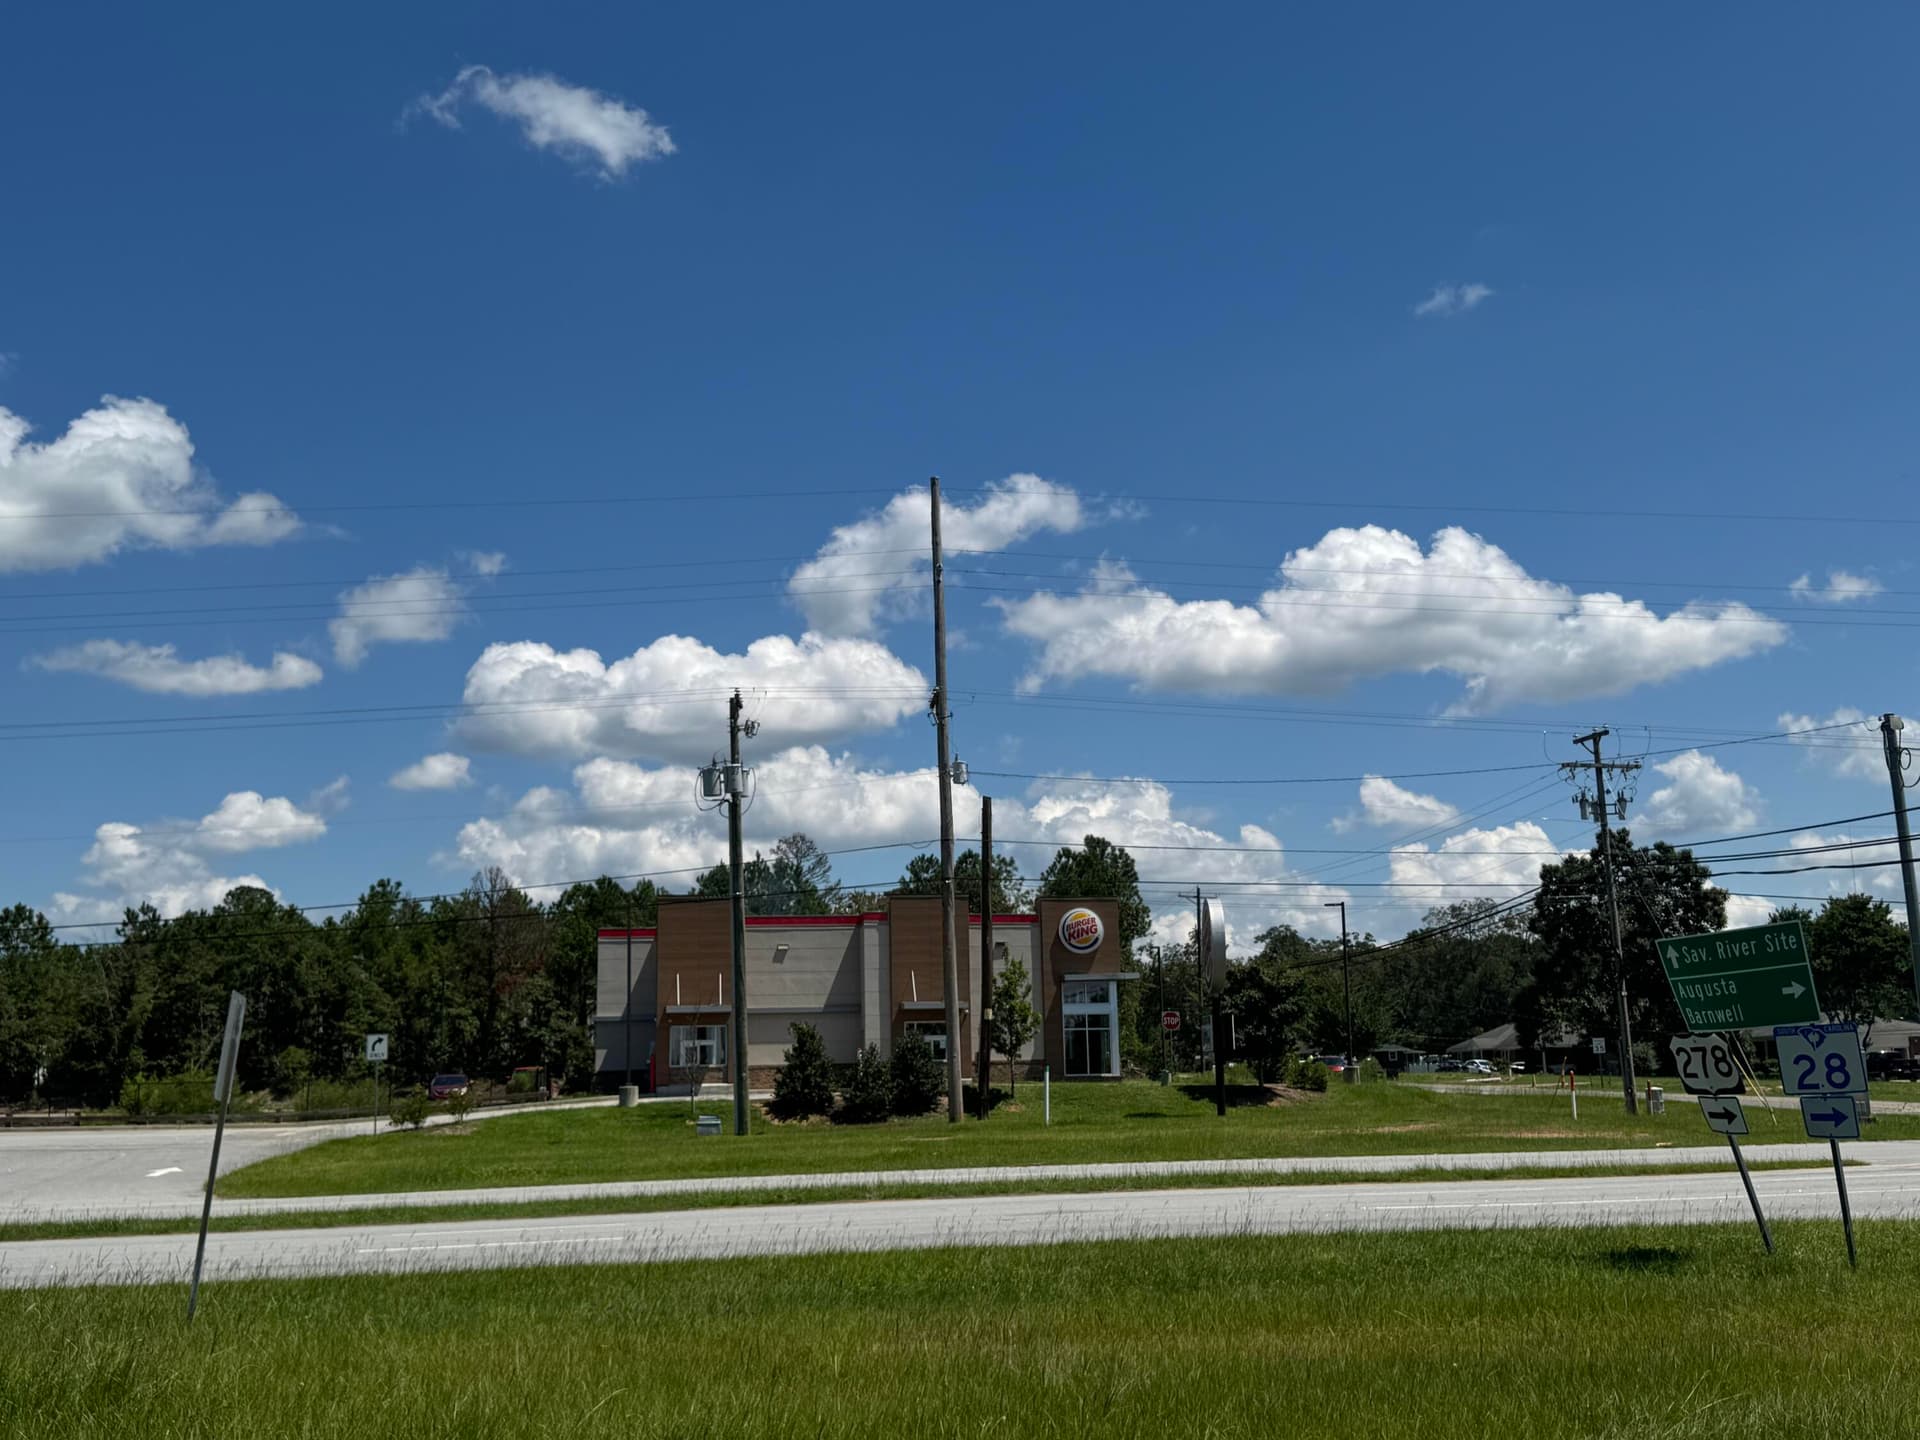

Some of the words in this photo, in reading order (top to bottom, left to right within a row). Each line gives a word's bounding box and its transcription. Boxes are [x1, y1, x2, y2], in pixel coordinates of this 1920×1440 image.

[1067, 917, 1096, 930] BURGER
[1068, 925, 1098, 942] KING
[1681, 945, 1712, 964] Sav.
[1716, 940, 1757, 959] River
[1764, 932, 1797, 953] Site
[1678, 978, 1737, 1000] Augusta
[1163, 1016, 1179, 1025] STOP
[1685, 1003, 1744, 1024] Barnwell
[1676, 1045, 1733, 1078] 278
[1793, 1053, 1850, 1090] 28
